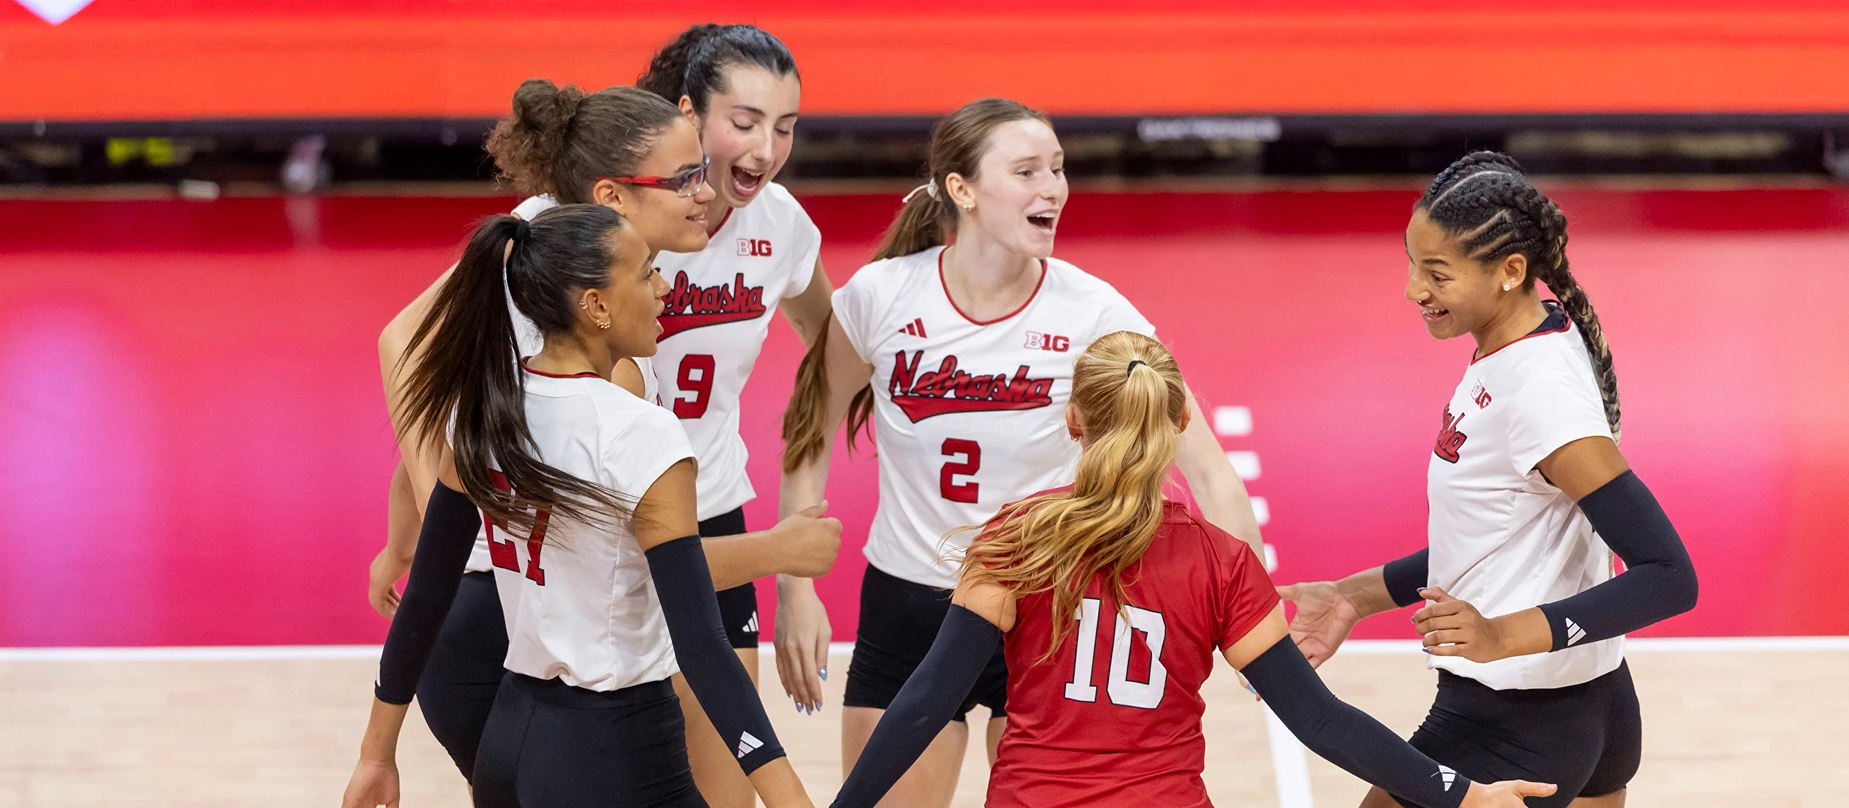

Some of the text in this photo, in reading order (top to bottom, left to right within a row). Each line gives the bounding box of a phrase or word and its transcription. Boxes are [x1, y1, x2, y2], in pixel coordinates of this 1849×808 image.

[657, 268, 766, 317] ebraska
[673, 353, 716, 420] 9
[888, 350, 1054, 404] Nebraska
[940, 437, 981, 504] 2
[1064, 596, 1168, 710] 10
